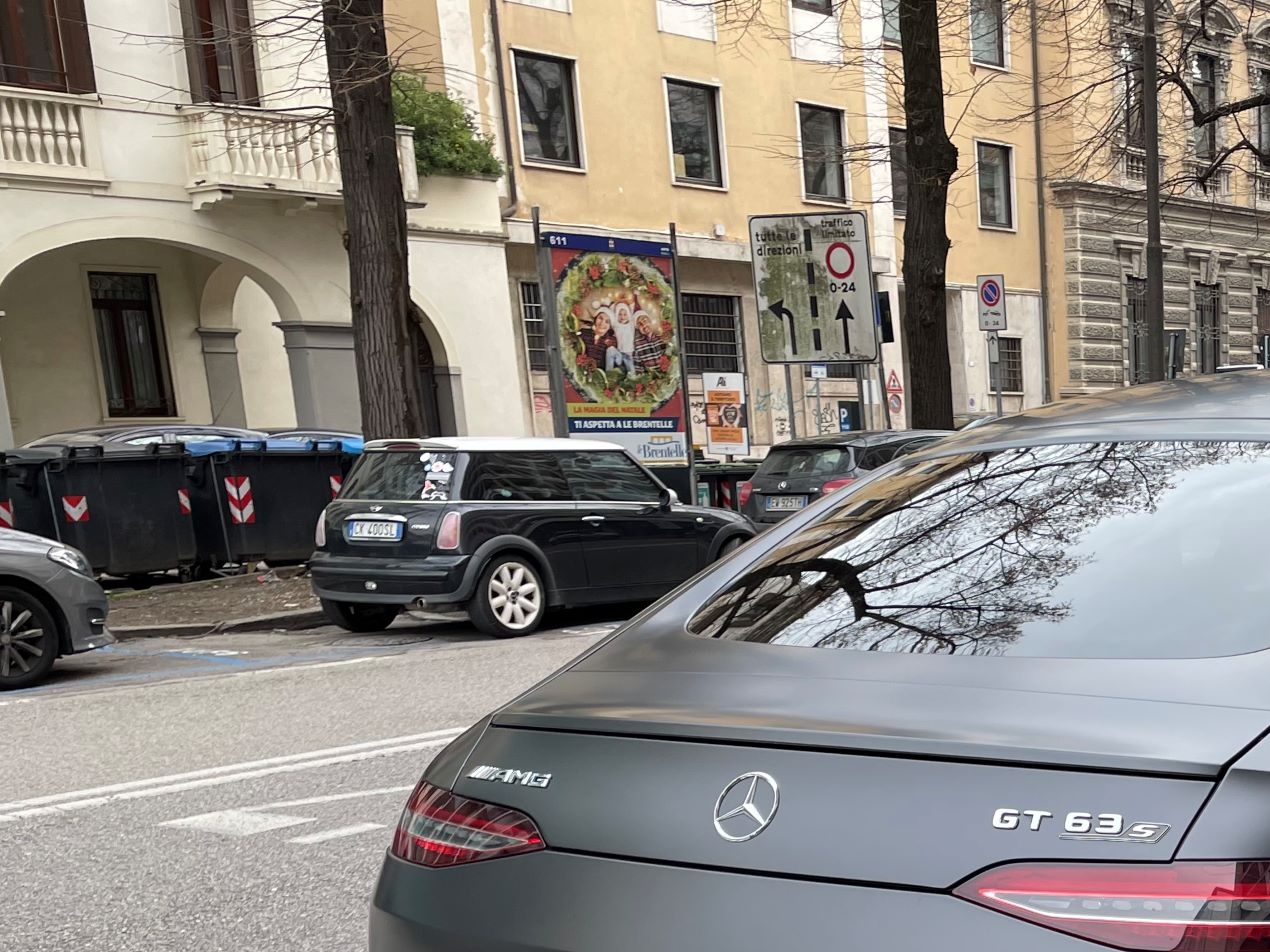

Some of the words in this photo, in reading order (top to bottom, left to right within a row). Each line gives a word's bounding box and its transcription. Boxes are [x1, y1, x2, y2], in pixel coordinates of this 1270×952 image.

[820, 217, 853, 228] traffico
[755, 231, 783, 242] tutte
[785, 230, 797, 241] le
[821, 229, 856, 238] limitato
[549, 235, 567, 246] 611
[756, 243, 802, 256] direzioni
[829, 281, 856, 293] 0-24
[621, 406, 646, 414] NATALE
[840, 408, 848, 423] P
[574, 420, 582, 429] TI
[583, 420, 616, 429] ASPETTA
[622, 420, 632, 429] LE
[633, 420, 674, 429] BRENTELLE
[992, 808, 1053, 832] GT
